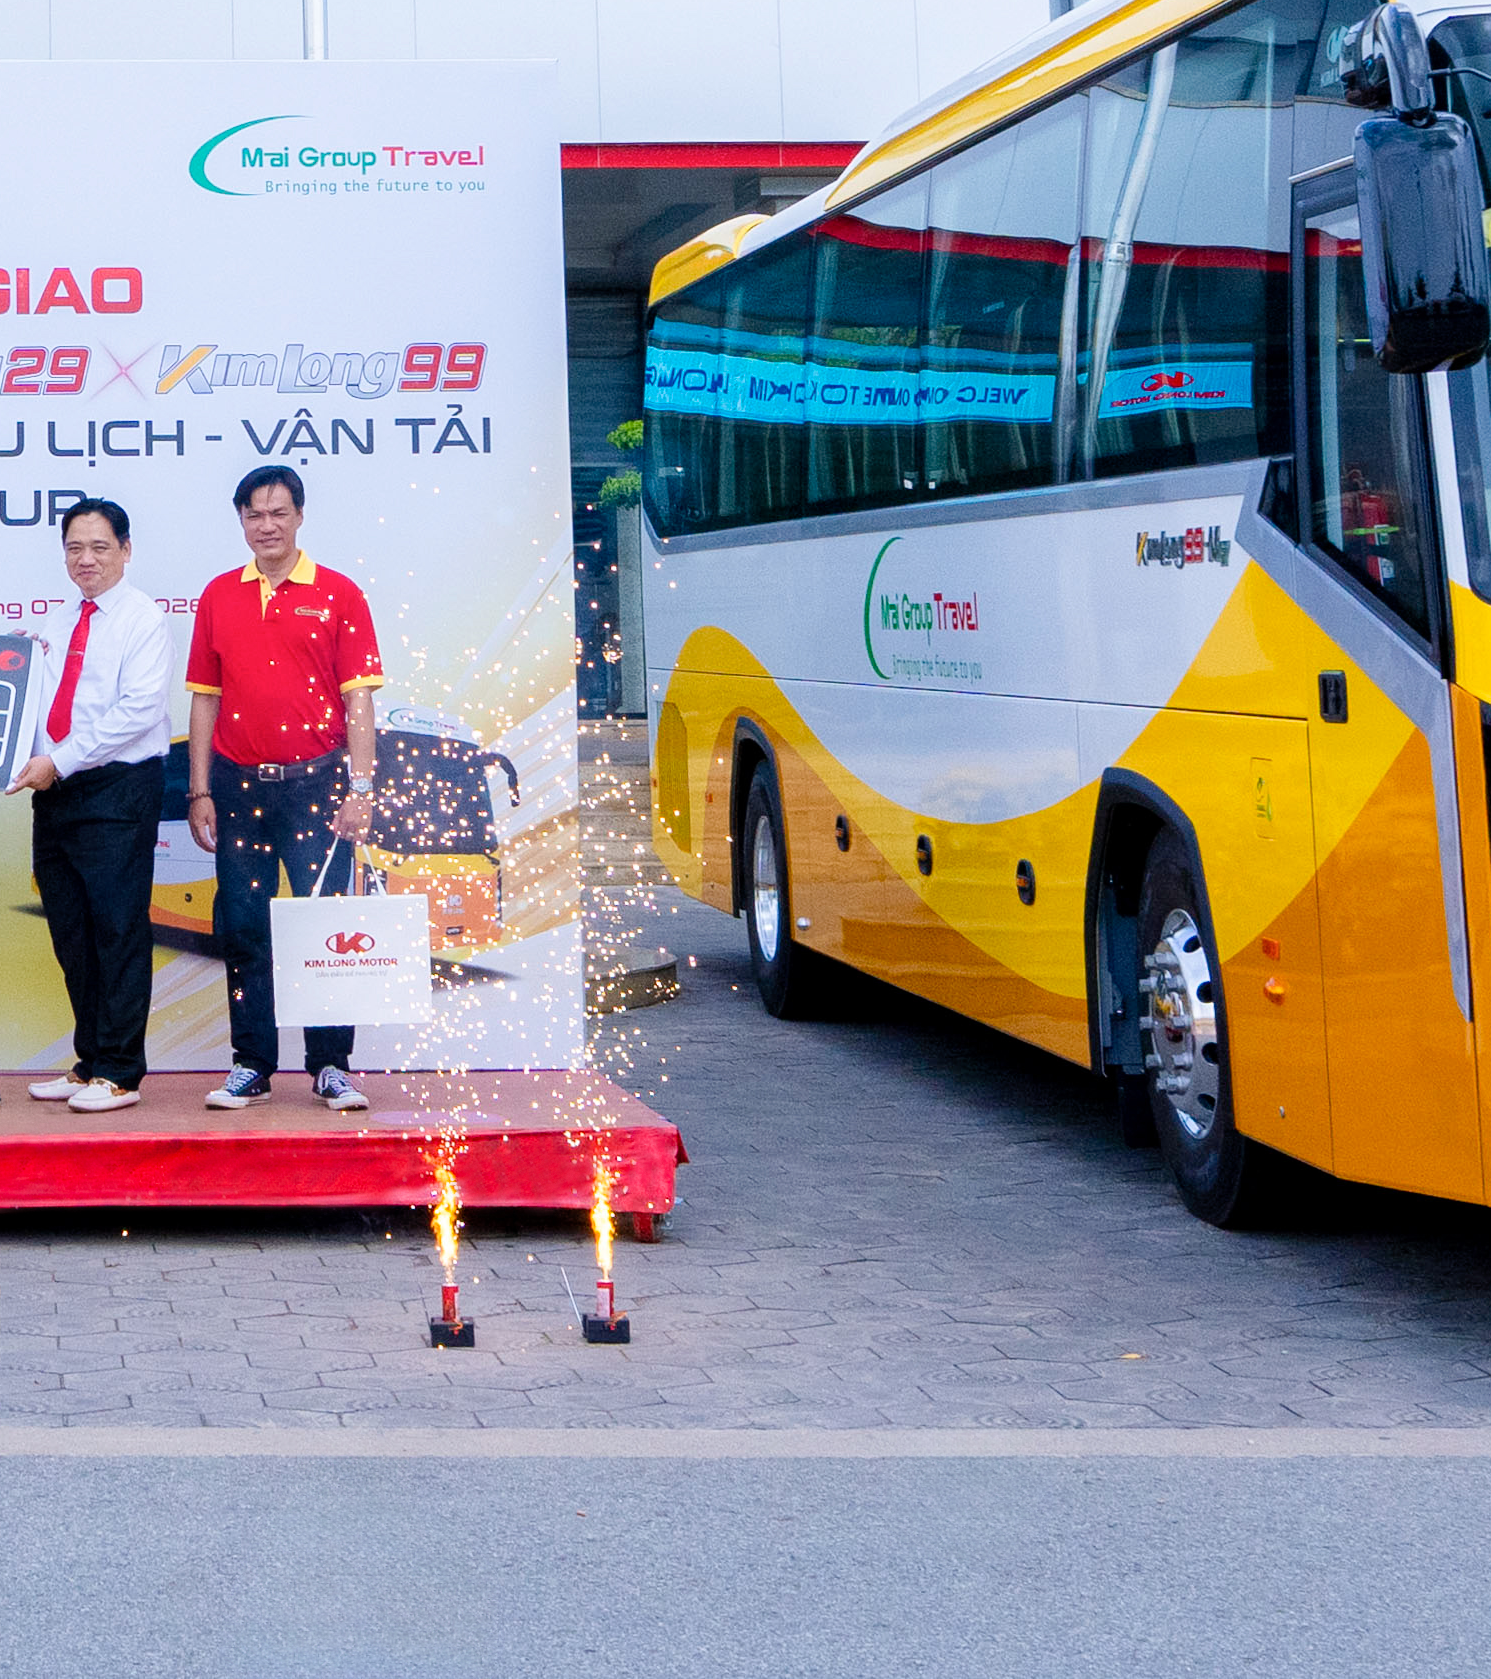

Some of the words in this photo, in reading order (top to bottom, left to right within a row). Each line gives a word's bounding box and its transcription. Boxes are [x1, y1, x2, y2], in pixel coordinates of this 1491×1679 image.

[299, 147, 376, 175] Group
[382, 146, 483, 166] Travel
[266, 181, 336, 195] Bringing
[344, 179, 369, 192] the
[377, 179, 429, 191] future
[436, 181, 452, 191] to
[459, 181, 484, 193] you
[48, 420, 184, 467] LỊCH
[241, 408, 374, 465] VẬN
[395, 404, 491, 454] TẢI
[902, 593, 933, 647] Group
[933, 591, 979, 631] Travel
[305, 960, 325, 968] KIM
[327, 959, 356, 967] LONG
[359, 958, 398, 966] MOTOR
